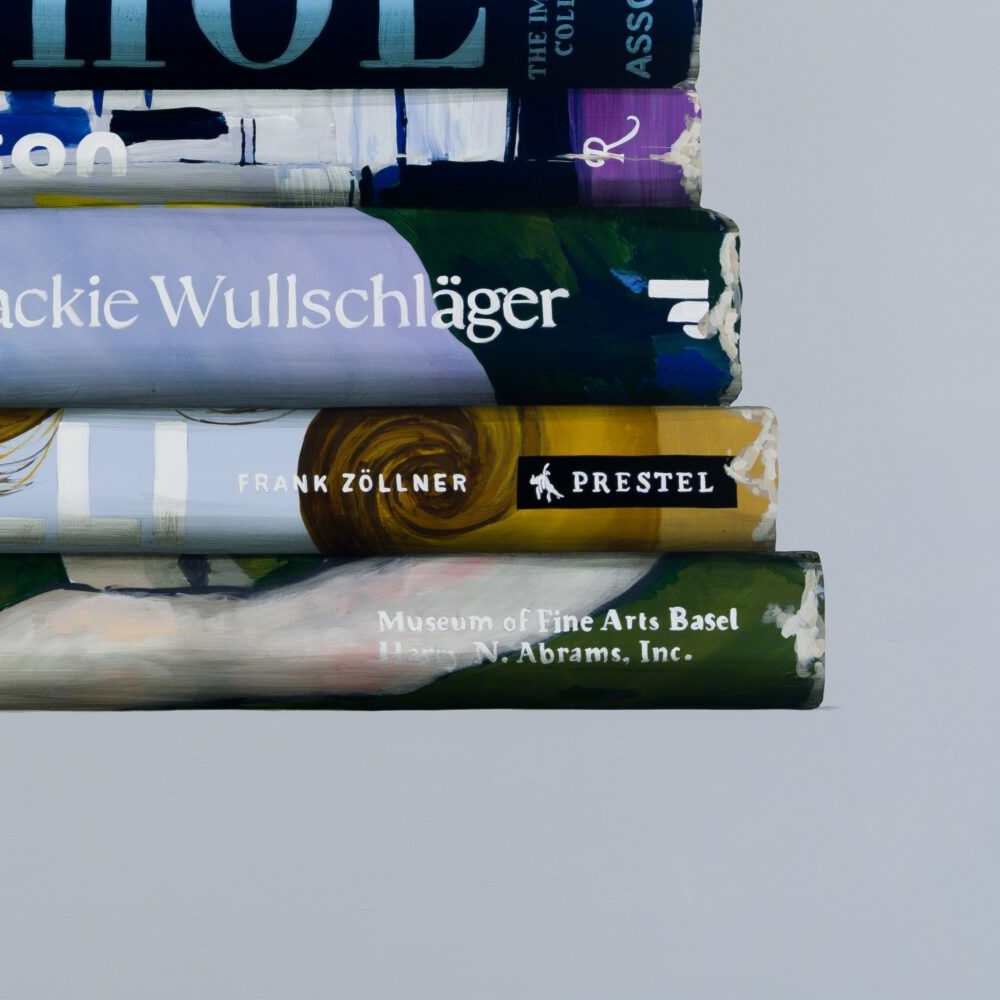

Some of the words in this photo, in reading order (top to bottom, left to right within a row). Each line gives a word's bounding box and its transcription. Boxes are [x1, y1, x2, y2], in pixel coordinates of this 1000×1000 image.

[528, 31, 548, 80] THE
[150, 272, 570, 344] Wullschläger
[237, 473, 328, 494] FRANK
[341, 468, 468, 495] ZÖLLNER
[572, 470, 715, 495] PRESTEL
[377, 609, 493, 633] Museum
[503, 607, 530, 632] of
[538, 608, 593, 633] Fine
[600, 608, 660, 632] Arts
[669, 606, 740, 631] Basel
[473, 641, 508, 665] N.
[518, 640, 631, 666] Abrams,
[639, 640, 694, 664] Inc.
